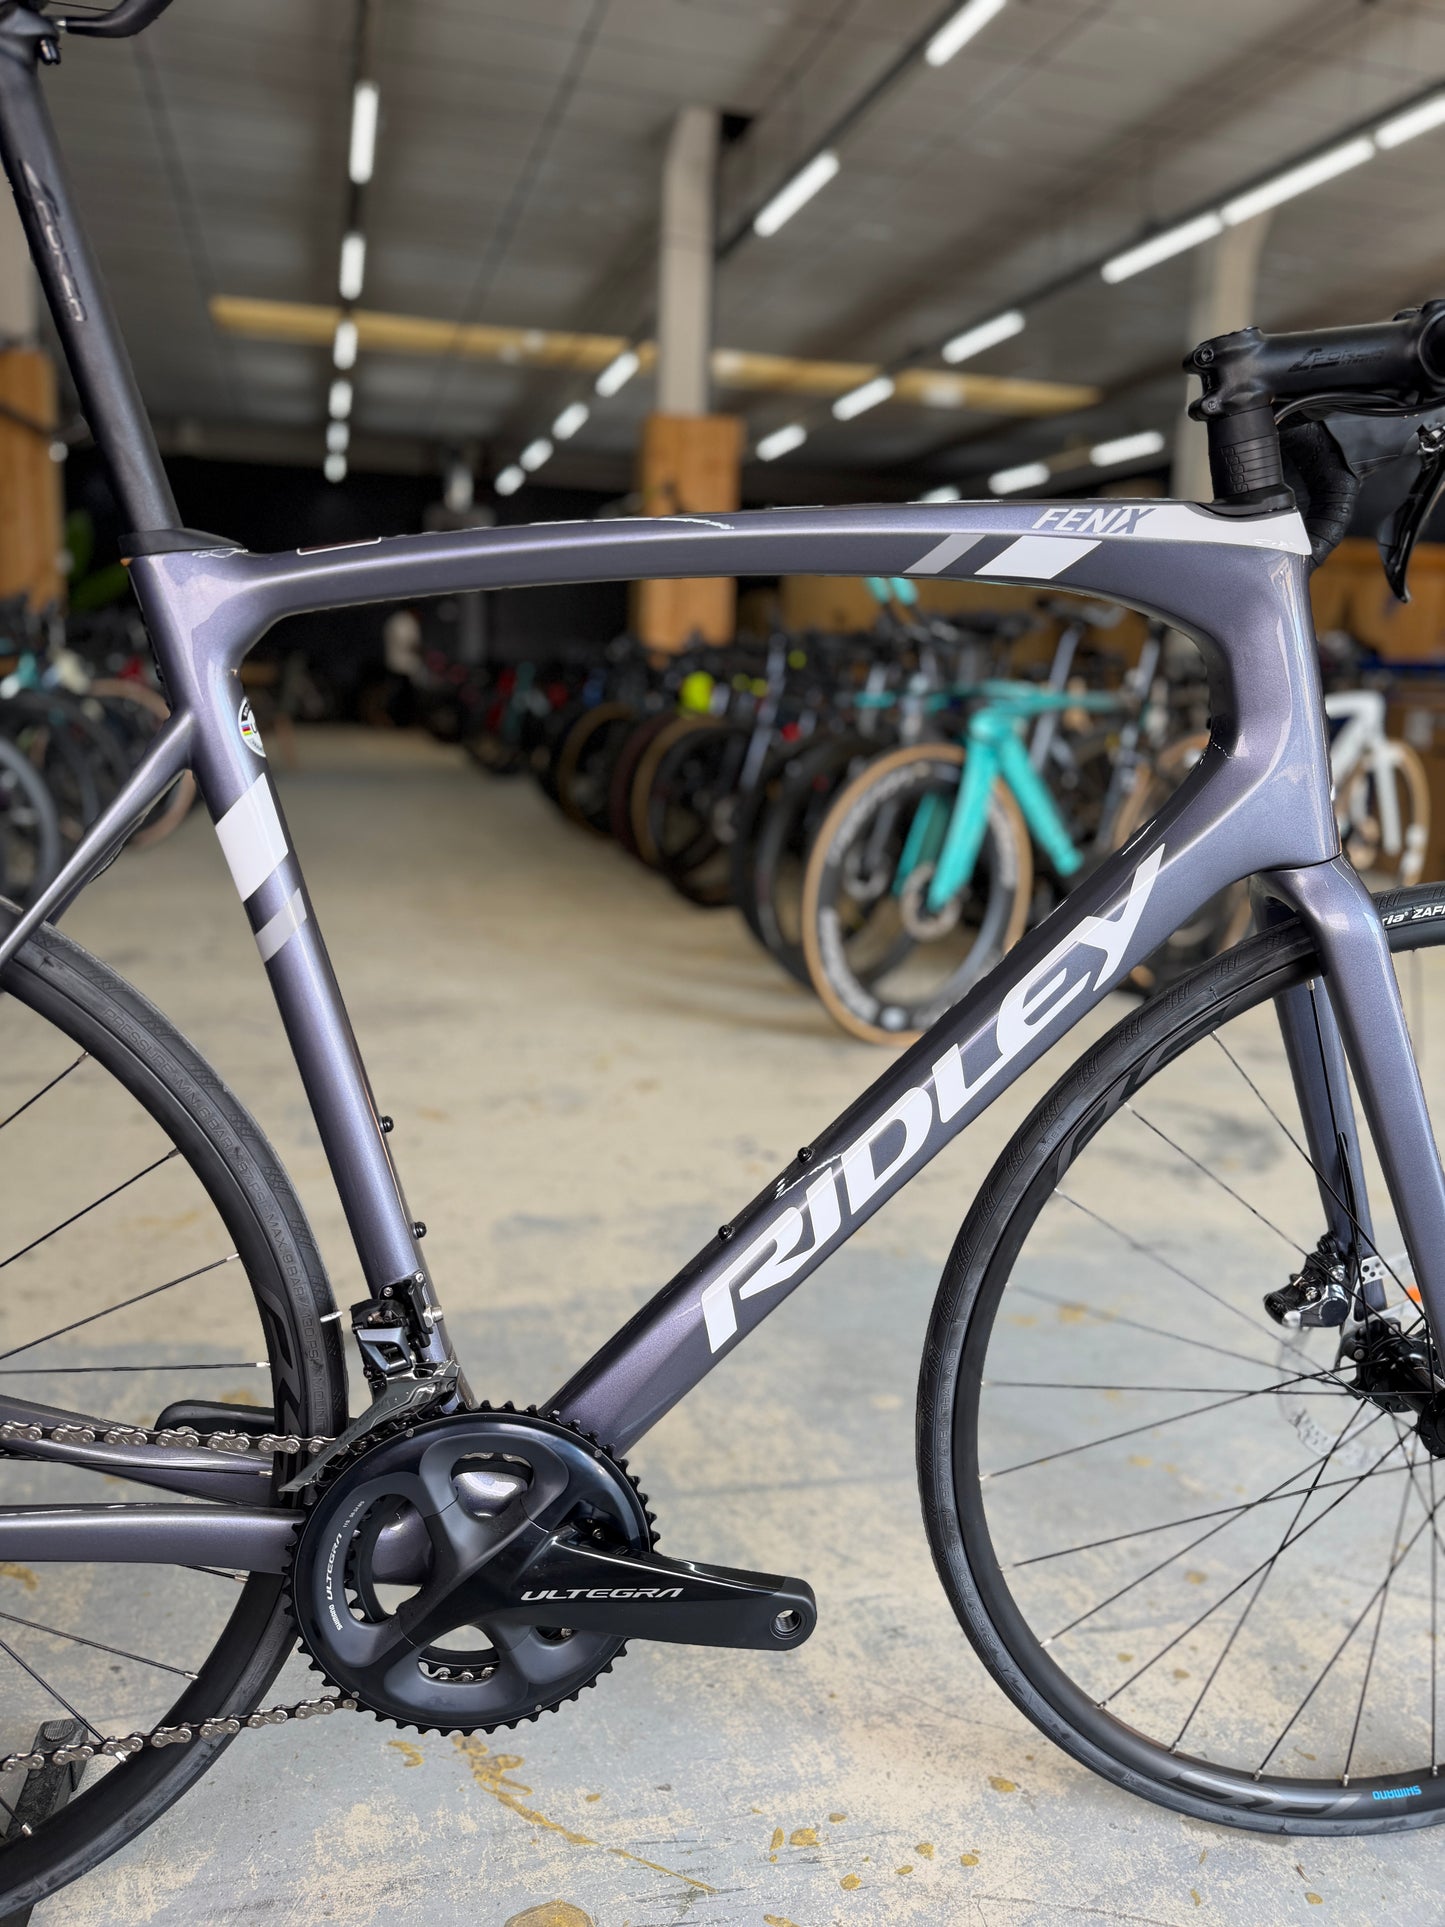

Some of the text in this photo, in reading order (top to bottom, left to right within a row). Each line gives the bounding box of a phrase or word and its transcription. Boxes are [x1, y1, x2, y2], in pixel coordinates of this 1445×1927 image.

[701, 843, 1165, 1354] RIDLEY
[326, 1532, 342, 1600] ULTEGRA
[520, 1587, 684, 1601] ULTEGRA
